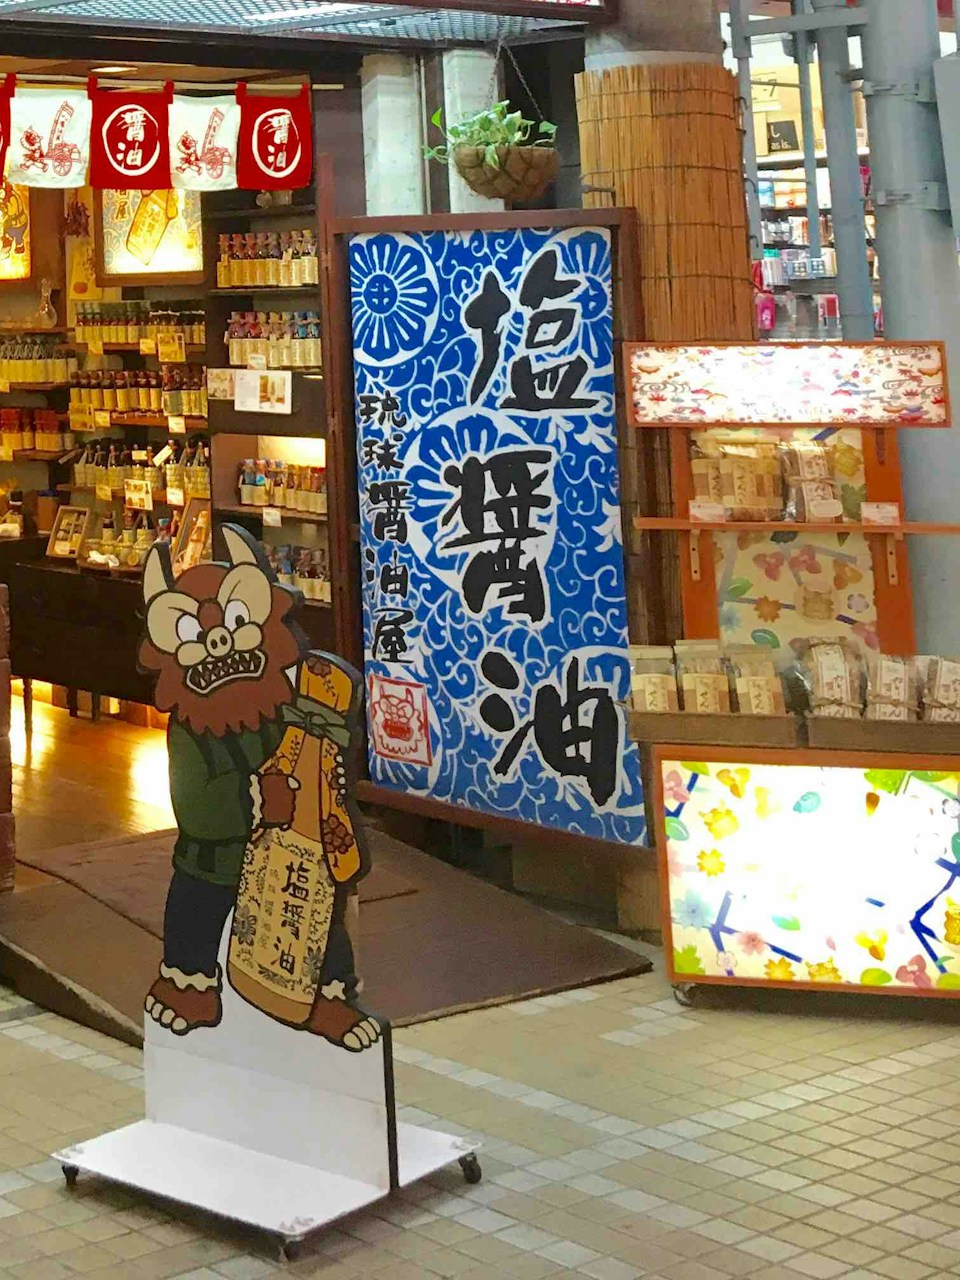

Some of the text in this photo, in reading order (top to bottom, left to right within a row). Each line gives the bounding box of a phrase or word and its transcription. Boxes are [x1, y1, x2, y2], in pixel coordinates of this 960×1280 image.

[116, 109, 148, 168] 醤油
[262, 114, 292, 171] 醤油
[357, 391, 415, 665] 琉球醤油屋
[440, 248, 622, 810] 塩醤油
